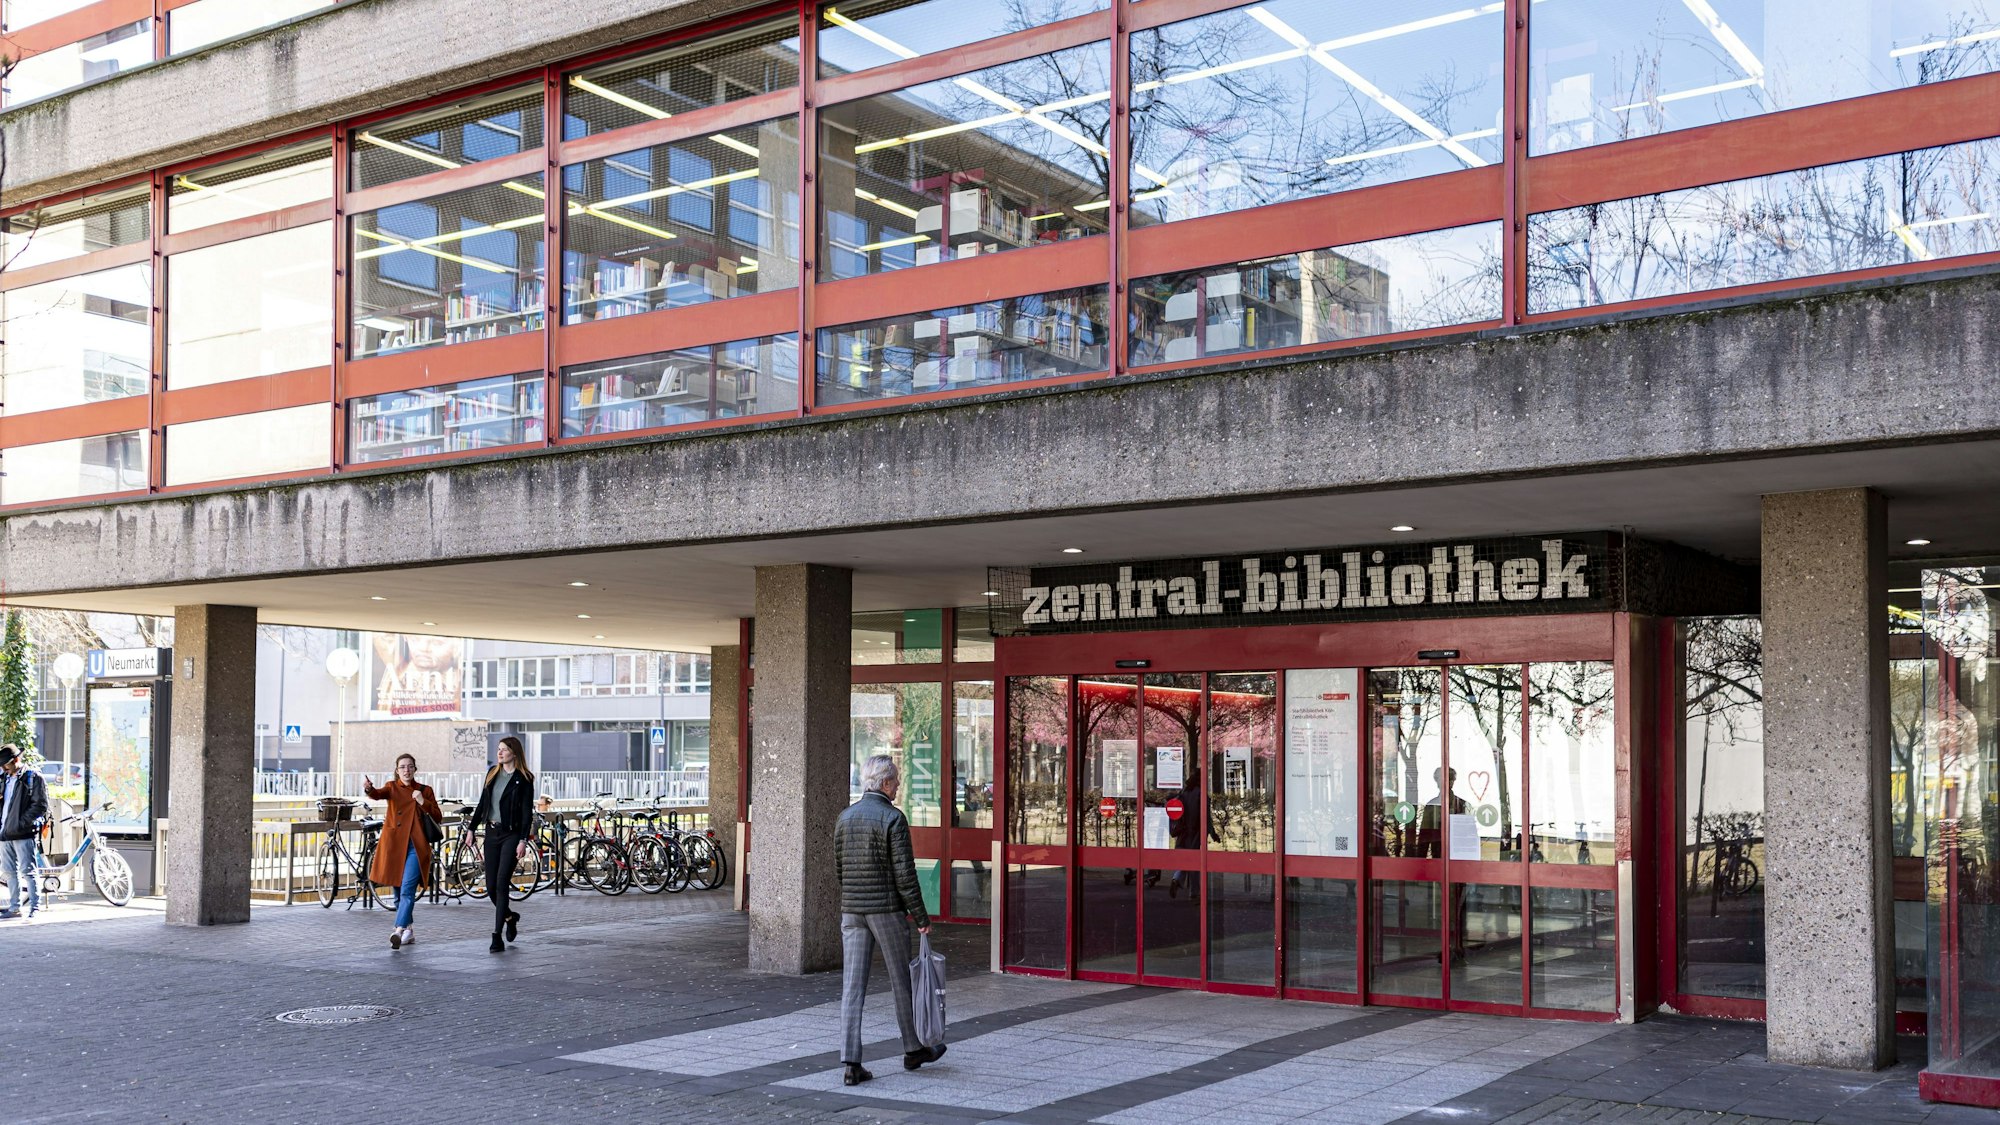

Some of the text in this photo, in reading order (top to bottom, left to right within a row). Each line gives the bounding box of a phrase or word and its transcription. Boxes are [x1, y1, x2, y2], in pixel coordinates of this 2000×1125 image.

[1022, 538, 1589, 624] zentral-bibliothek
[91, 654, 155, 674] U Neumarkt
[391, 703, 456, 715] COMING SOON
